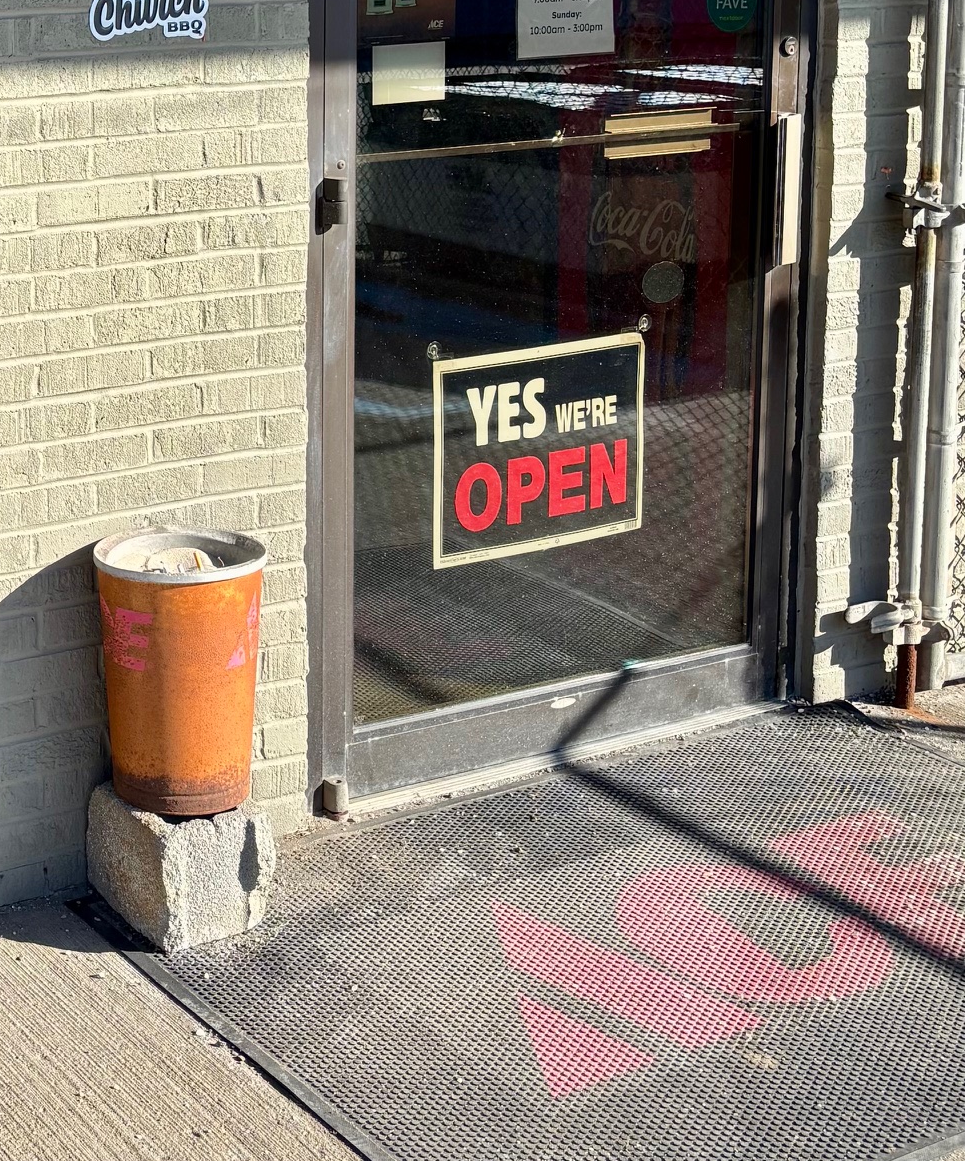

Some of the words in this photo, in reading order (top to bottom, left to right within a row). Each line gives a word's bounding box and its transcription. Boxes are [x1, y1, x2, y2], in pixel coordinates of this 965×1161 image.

[551, 10, 582, 20] Sunday:
[166, 19, 203, 35] BBQ
[427, 19, 444, 29] ACE
[530, 25, 565, 36] 10:00am
[572, 24, 603, 36] 3:00pm
[589, 191, 696, 263] Coca-Cola
[466, 377, 546, 447] YES
[555, 395, 618, 434] WE'RE
[453, 438, 628, 533] OPEN
